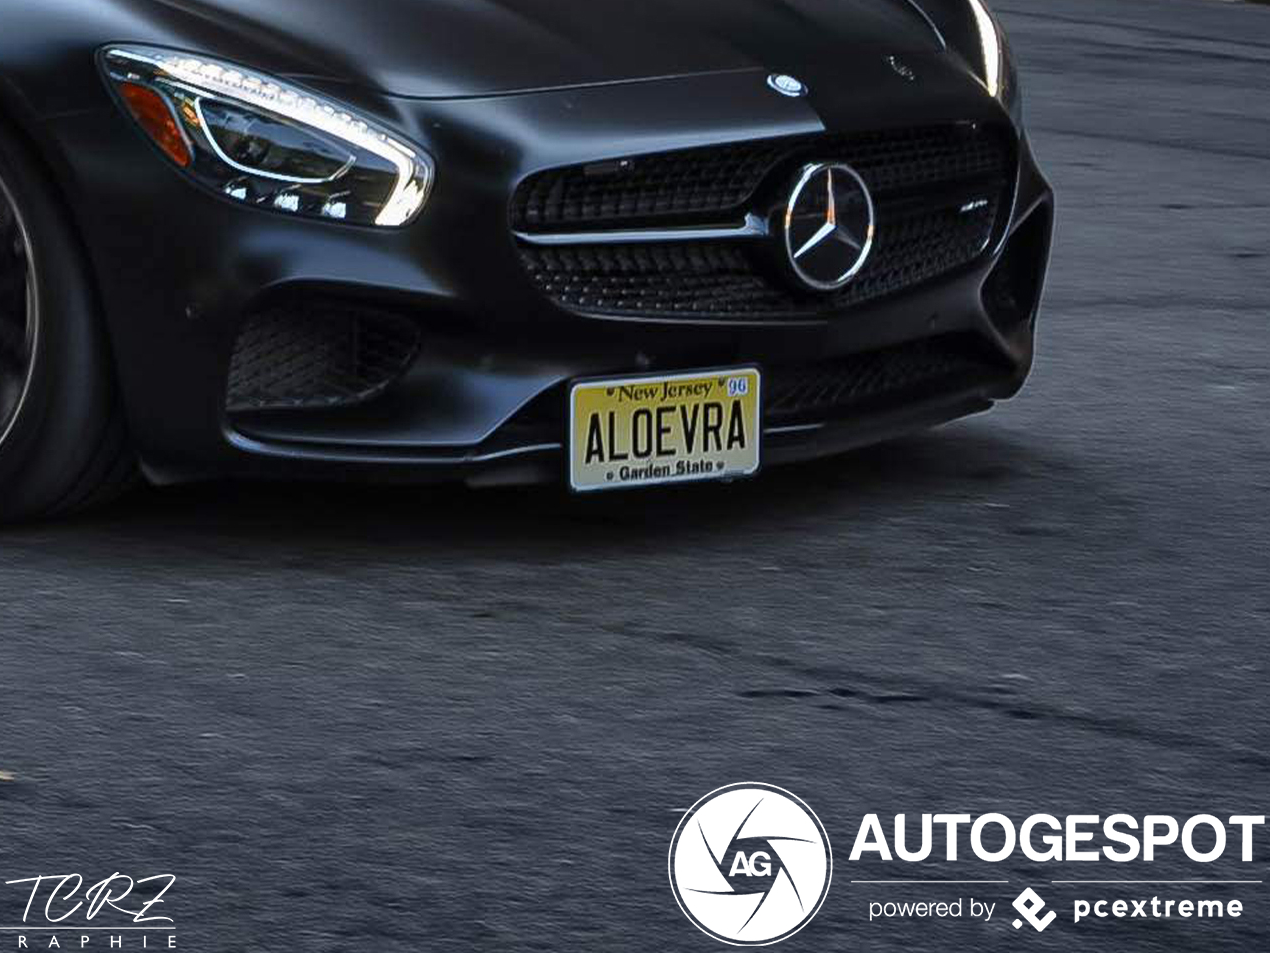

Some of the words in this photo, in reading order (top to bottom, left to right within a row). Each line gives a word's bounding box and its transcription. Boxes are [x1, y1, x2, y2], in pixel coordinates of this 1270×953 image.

[618, 385, 658, 402] New
[660, 381, 713, 401] Jersey
[585, 399, 747, 464] ALOEVRA
[619, 463, 670, 481] Garden
[675, 460, 713, 476] State
